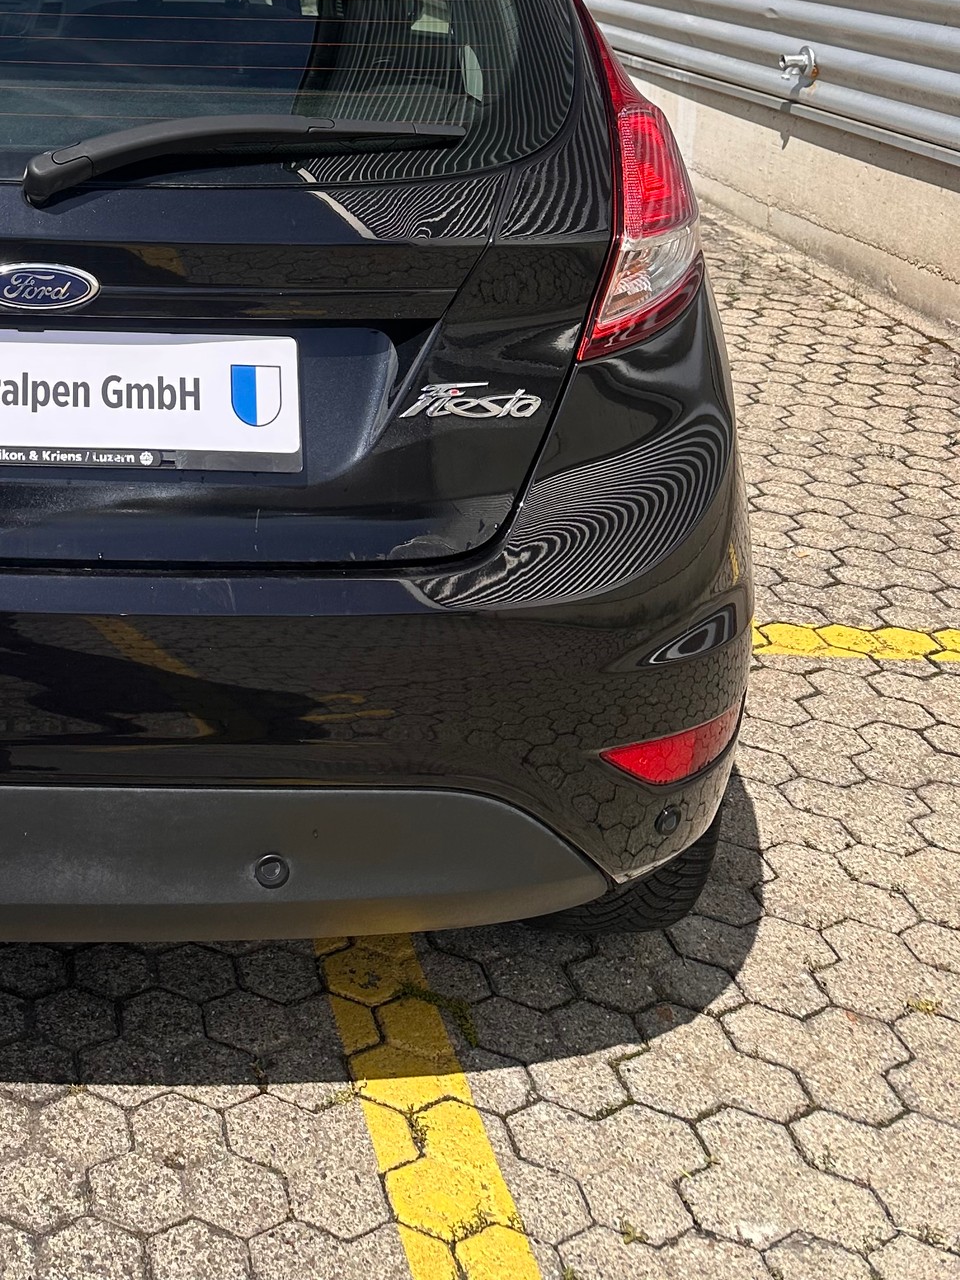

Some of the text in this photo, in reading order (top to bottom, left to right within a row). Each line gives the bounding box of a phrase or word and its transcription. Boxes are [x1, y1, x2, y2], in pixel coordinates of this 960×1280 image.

[3, 272, 72, 299] Ford
[101, 375, 201, 411] GmbH
[399, 381, 542, 418] Fiesta
[28, 450, 38, 461] &
[42, 450, 82, 462] Kriens
[93, 451, 136, 463] Luzern
